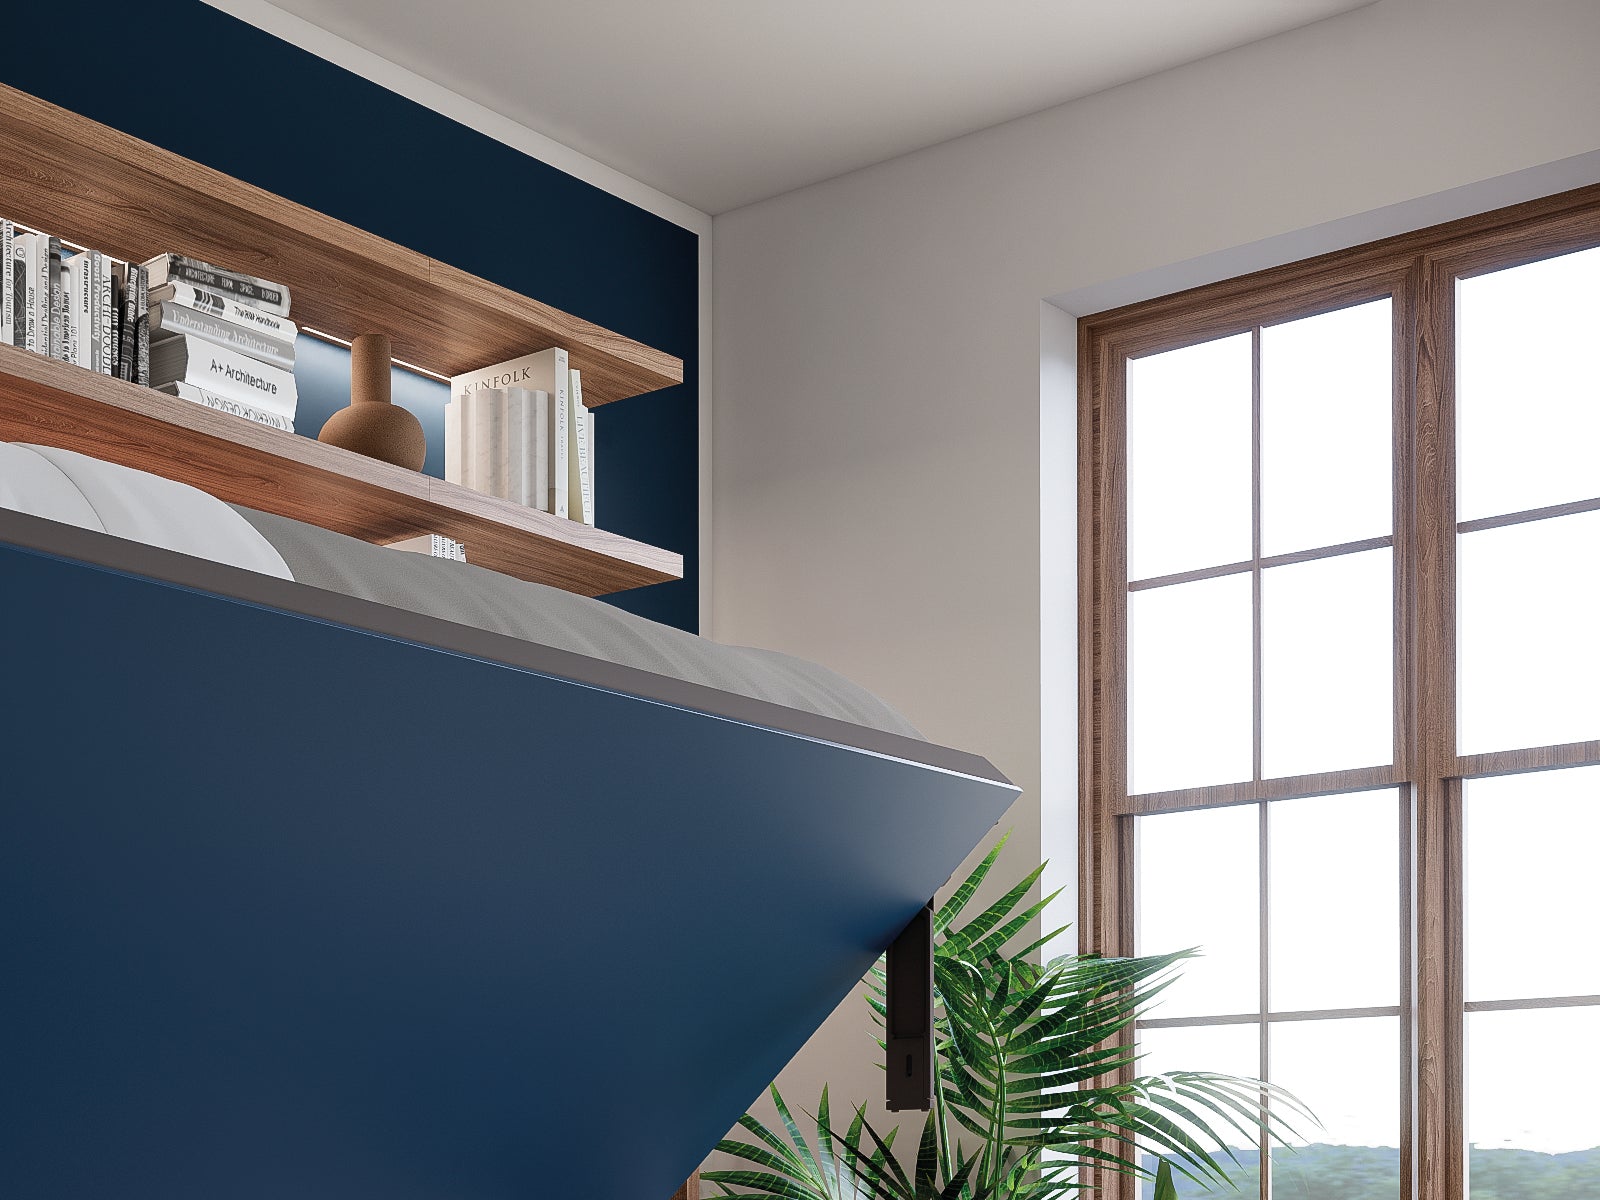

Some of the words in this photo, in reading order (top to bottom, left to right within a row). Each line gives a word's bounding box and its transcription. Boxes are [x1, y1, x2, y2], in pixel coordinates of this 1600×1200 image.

[27, 287, 35, 309] House
[51, 282, 60, 315] Design
[92, 283, 102, 342] Productivity
[172, 309, 231, 340] Understanding
[233, 330, 279, 355] Architecture
[209, 358, 224, 373] A+
[225, 364, 278, 395] Architecture
[464, 366, 531, 395] KINFOLK
